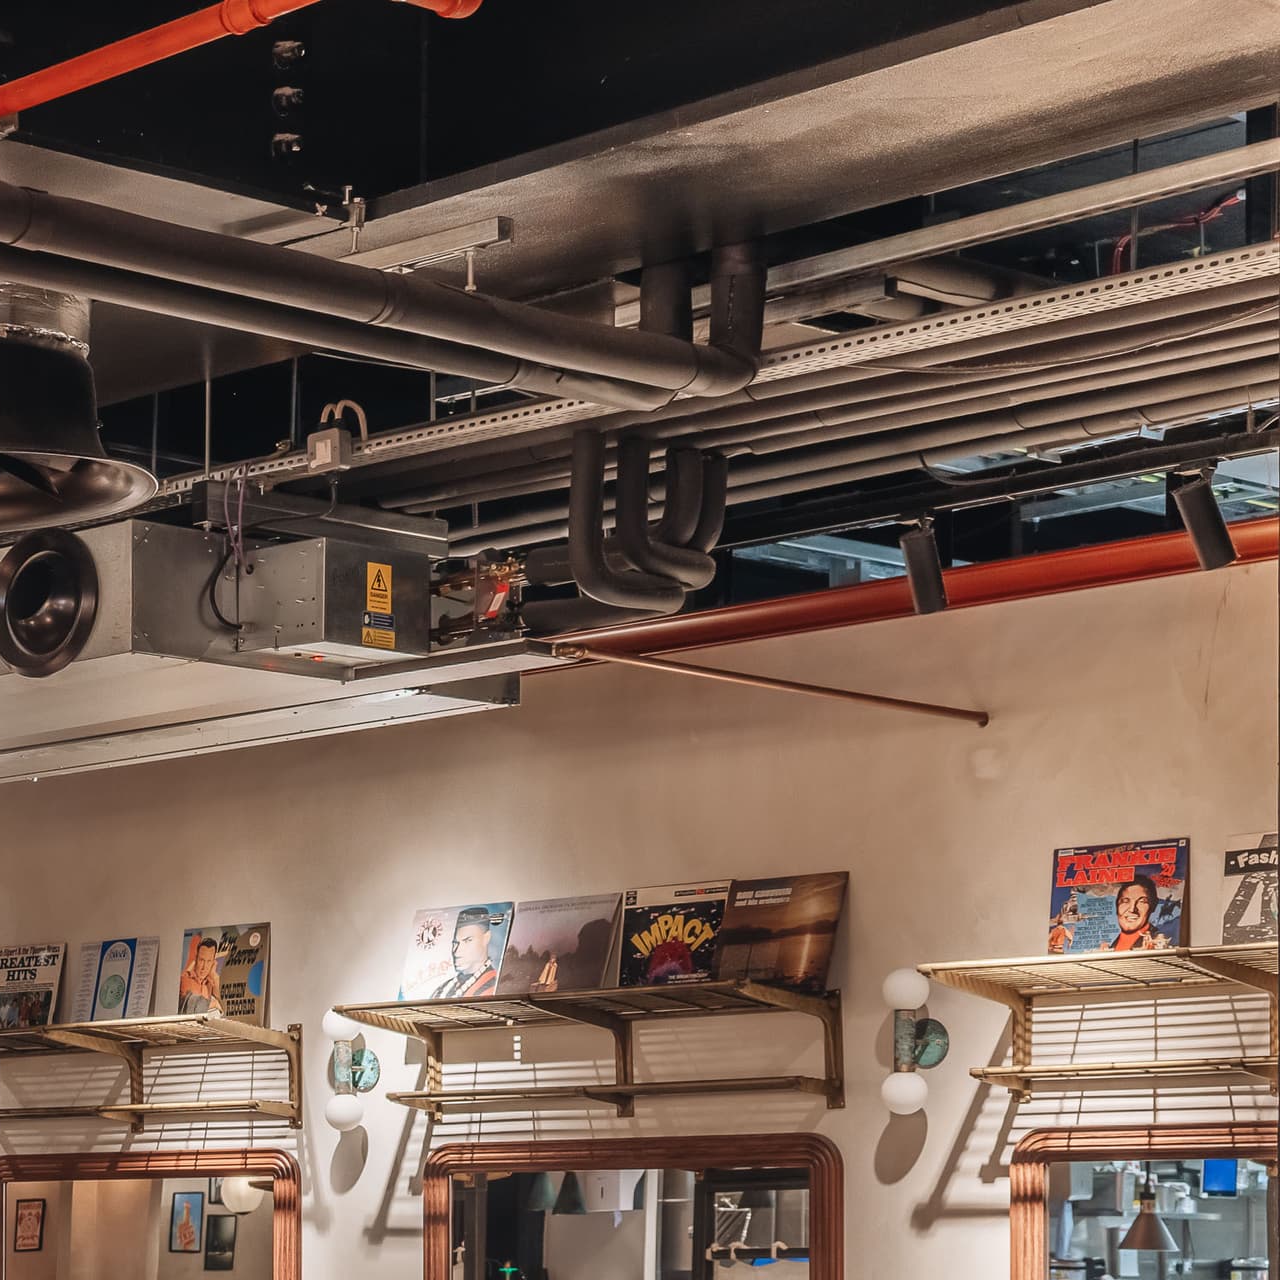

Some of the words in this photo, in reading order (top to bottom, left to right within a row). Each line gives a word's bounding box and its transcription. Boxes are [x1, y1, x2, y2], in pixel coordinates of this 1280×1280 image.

[1057, 847, 1177, 872] FRANKIE
[1056, 866, 1136, 888] LAINE
[631, 914, 715, 958] IMPACT
[6, 969, 37, 981] HITS
